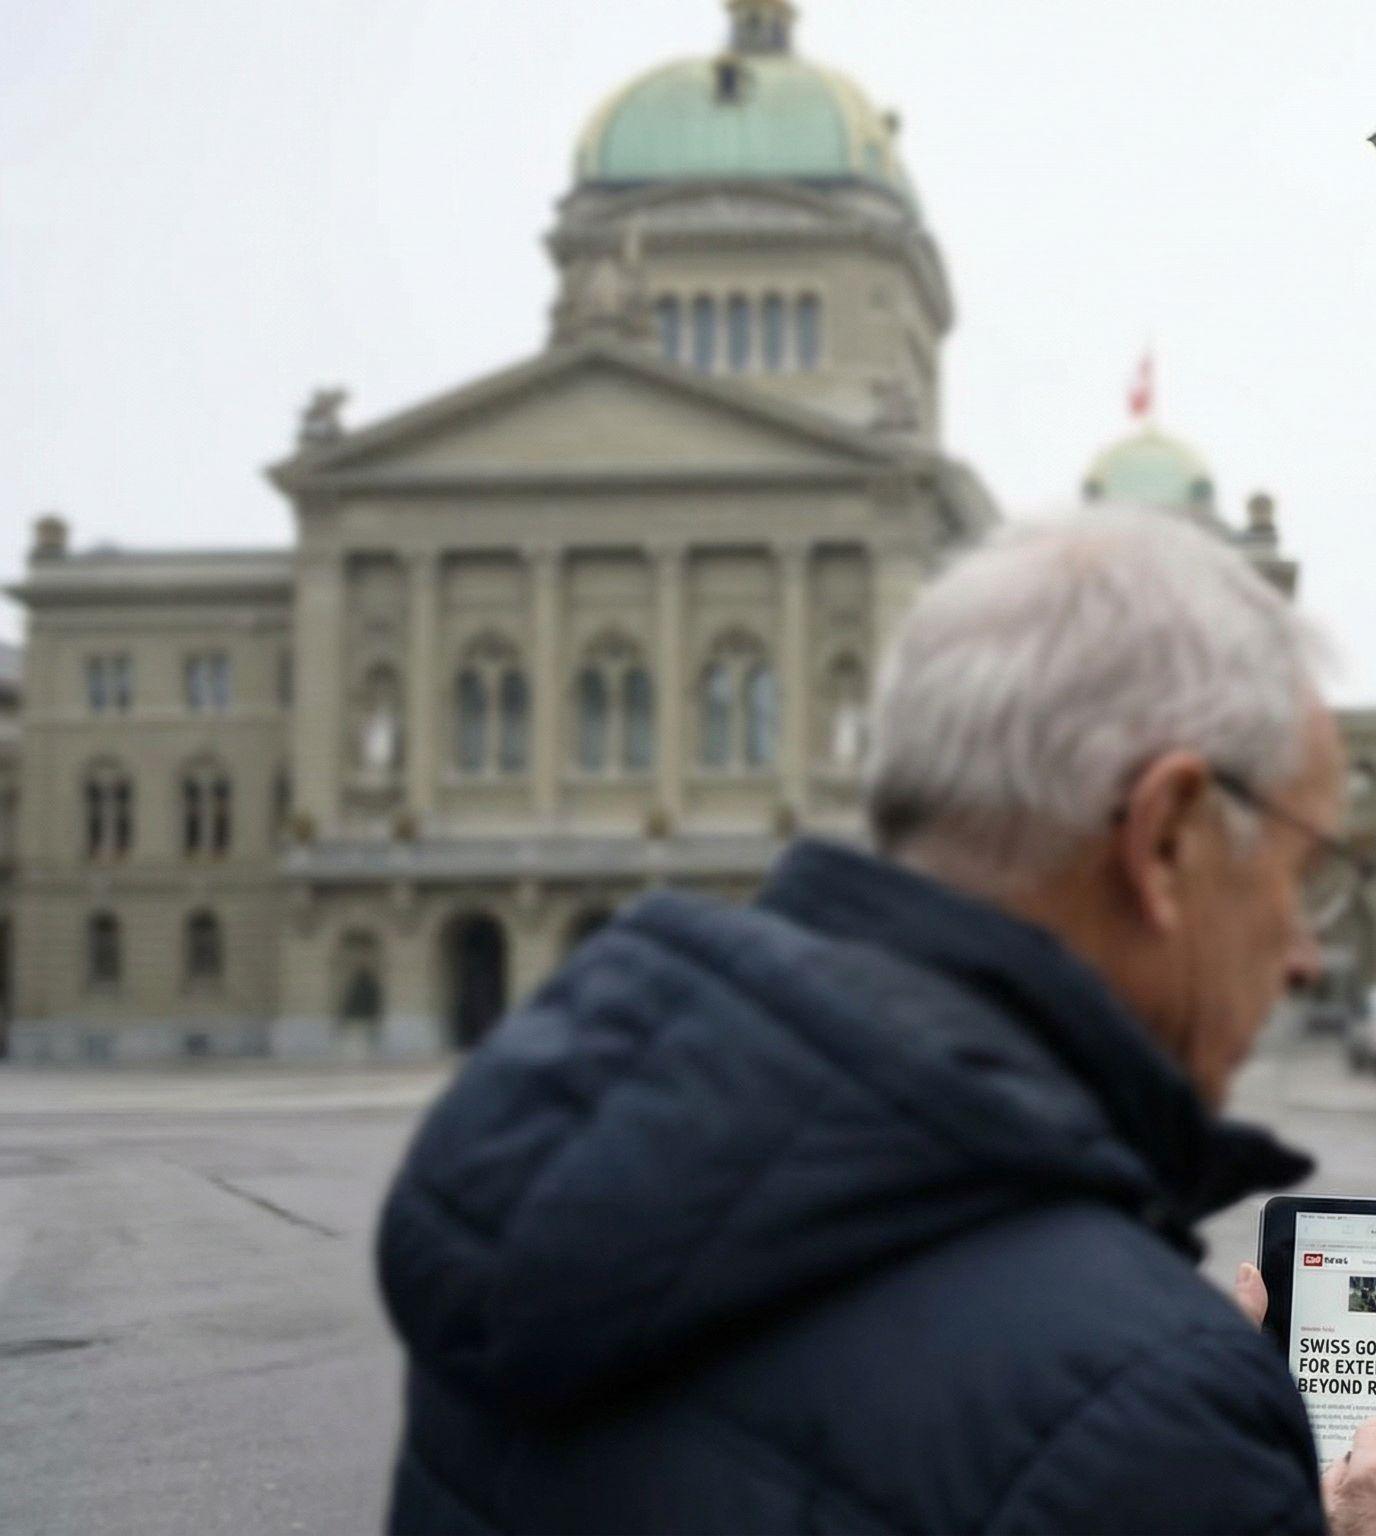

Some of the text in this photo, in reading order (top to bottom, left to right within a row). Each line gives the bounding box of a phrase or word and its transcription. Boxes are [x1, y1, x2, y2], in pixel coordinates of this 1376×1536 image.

[1299, 1337, 1351, 1355] SWISS
[1299, 1357, 1330, 1374] FOR
[1299, 1377, 1363, 1395] BEYOND
